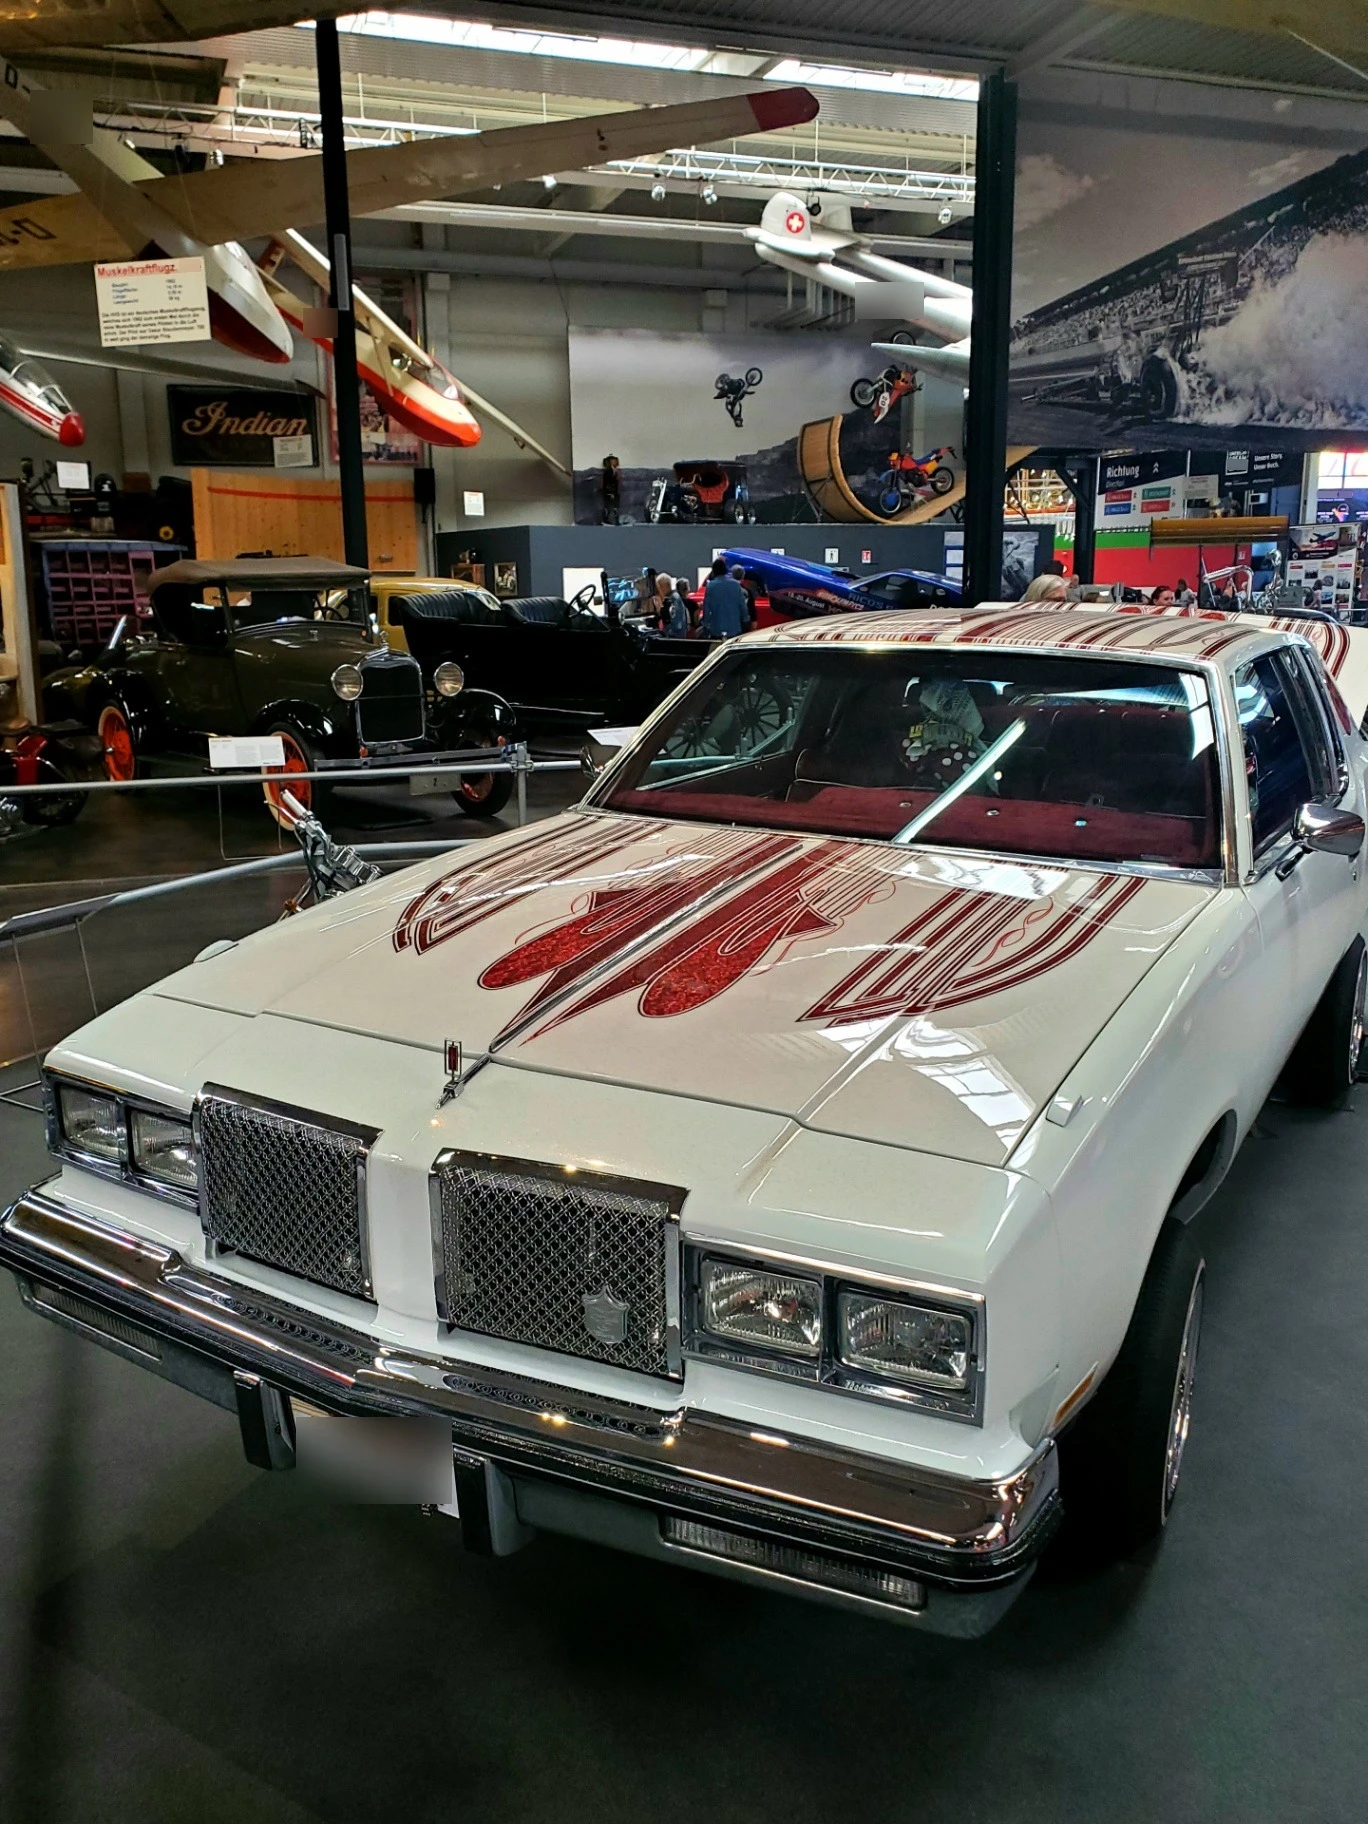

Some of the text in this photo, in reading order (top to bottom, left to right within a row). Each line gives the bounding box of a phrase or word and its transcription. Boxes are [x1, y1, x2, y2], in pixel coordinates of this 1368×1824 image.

[181, 401, 307, 436] Indian
[1106, 465, 1140, 478] Richtung
[804, 596, 826, 609] August
